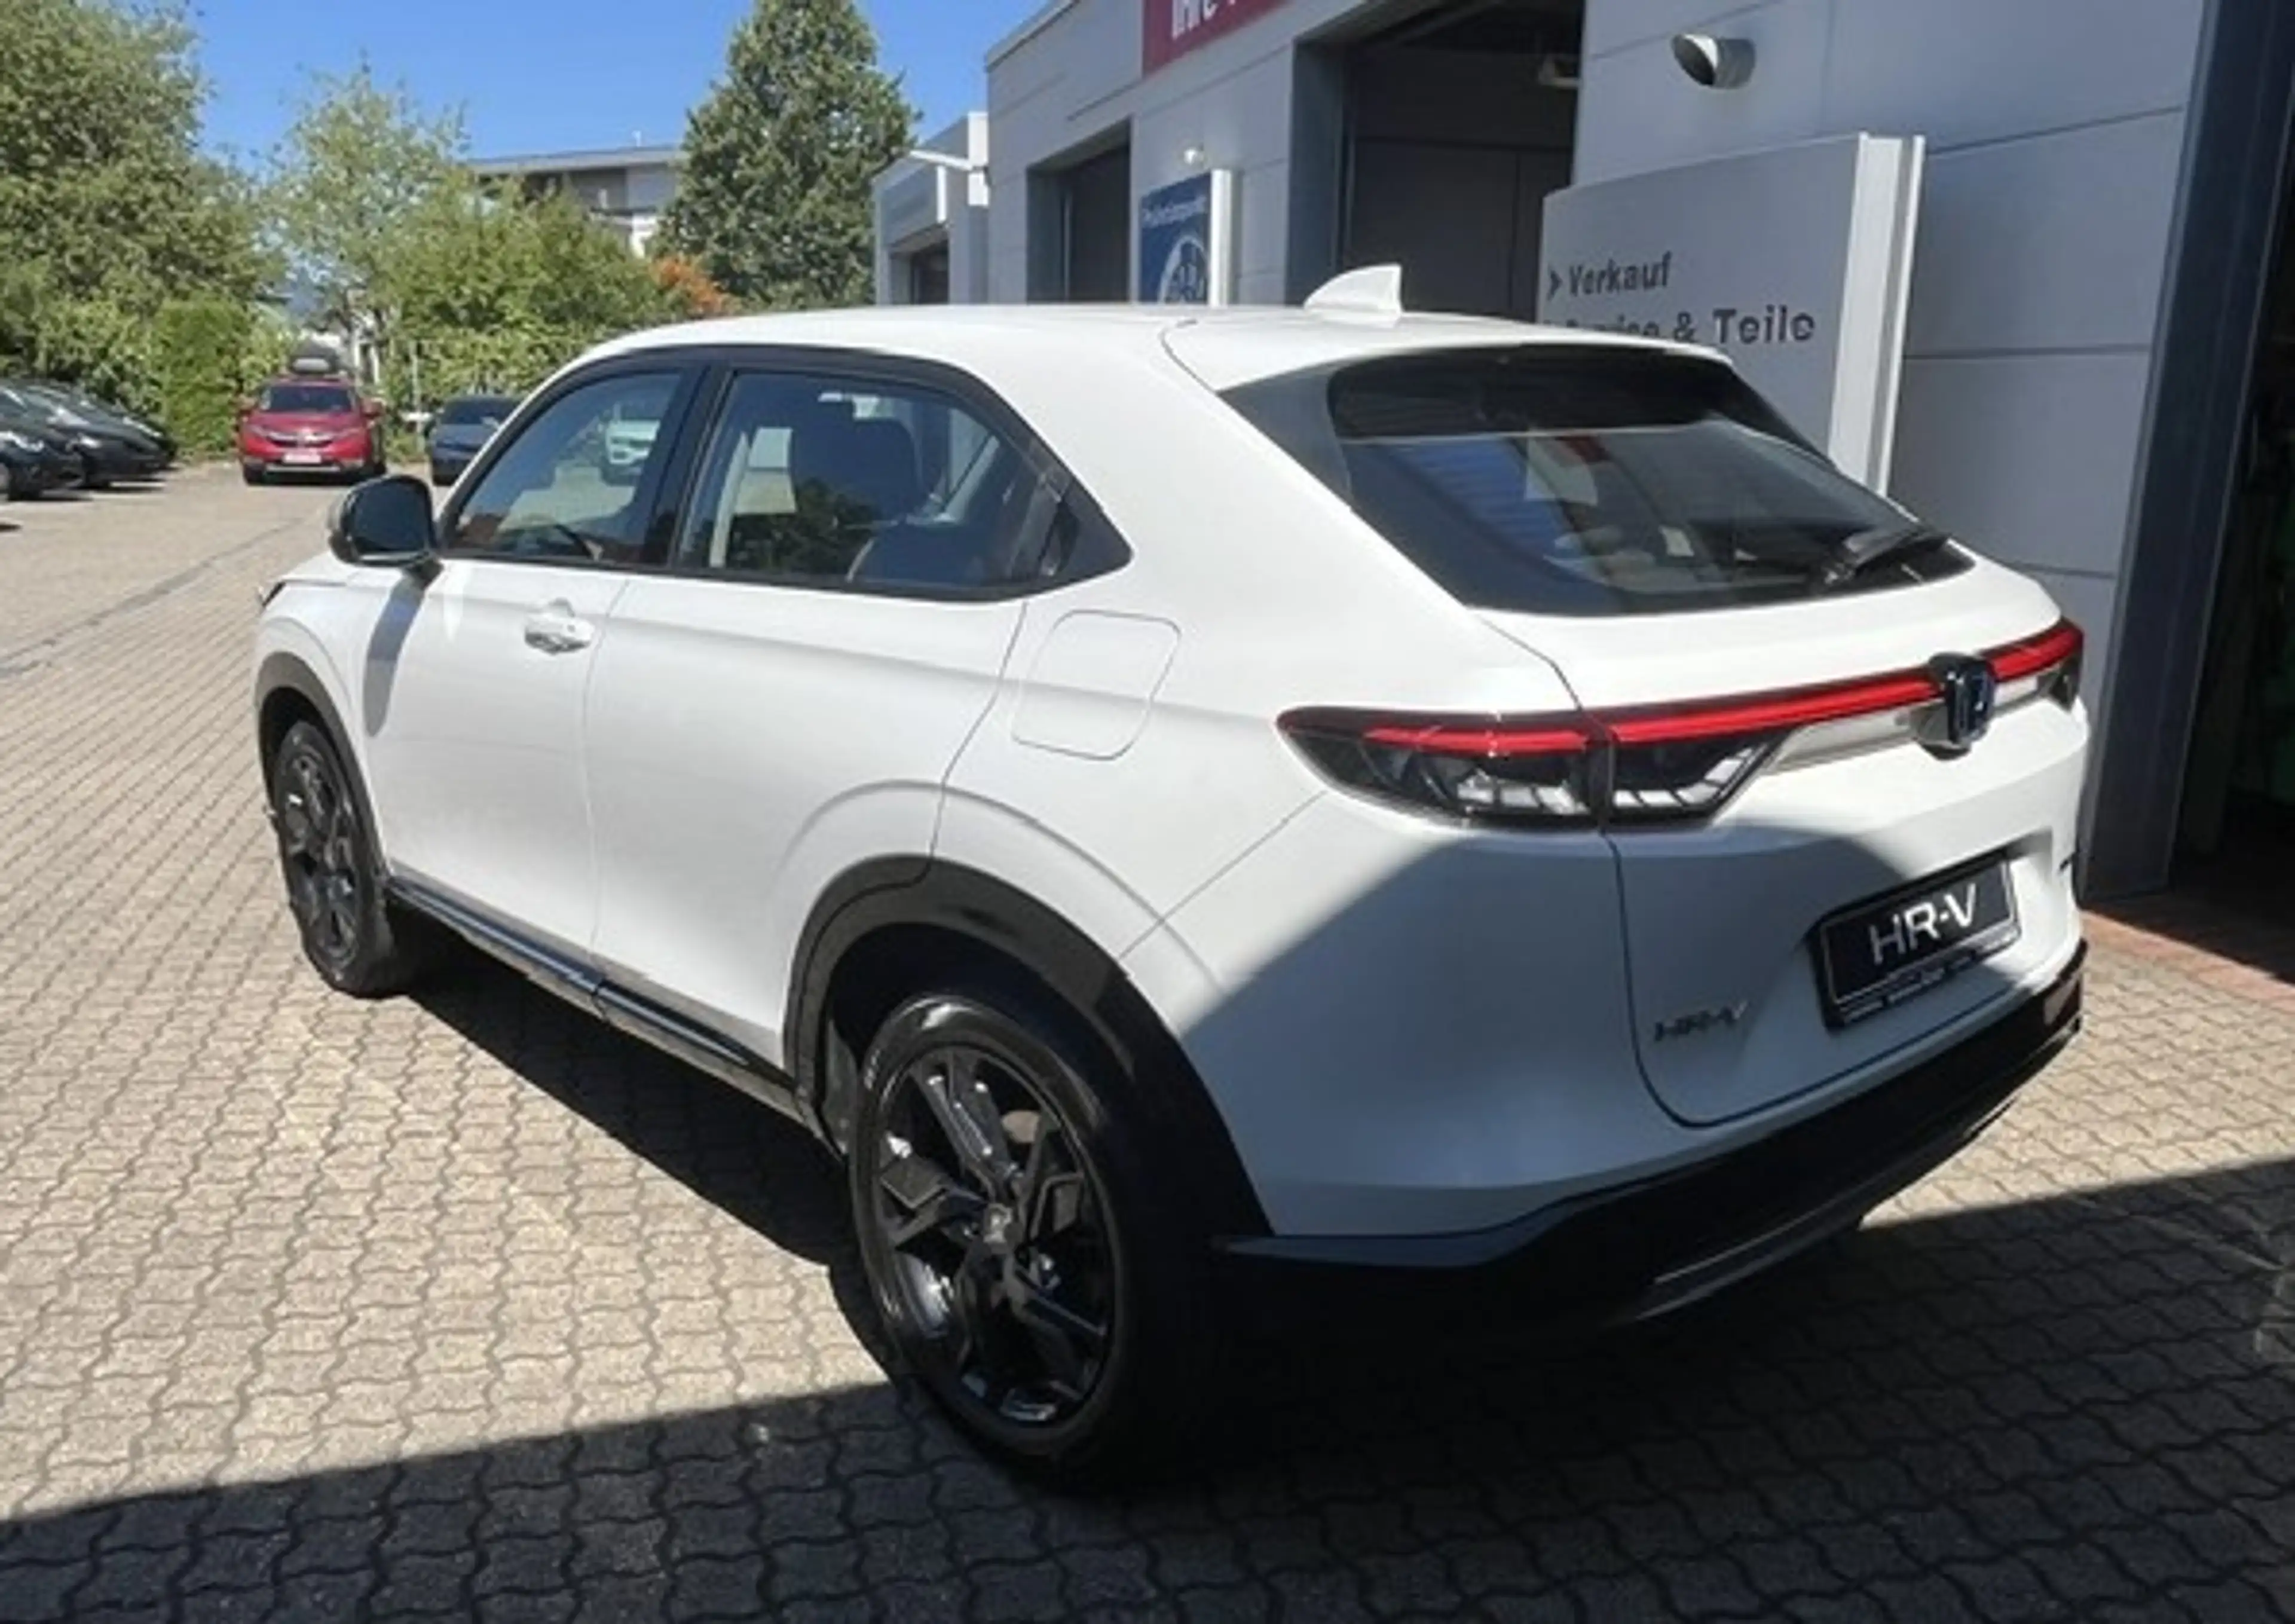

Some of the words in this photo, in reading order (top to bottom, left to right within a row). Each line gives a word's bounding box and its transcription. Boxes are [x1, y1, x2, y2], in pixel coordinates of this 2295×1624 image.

[1569, 250, 1672, 296] Verkauf
[1712, 304, 1814, 344] Teile
[1869, 883, 1976, 965] HR-V
